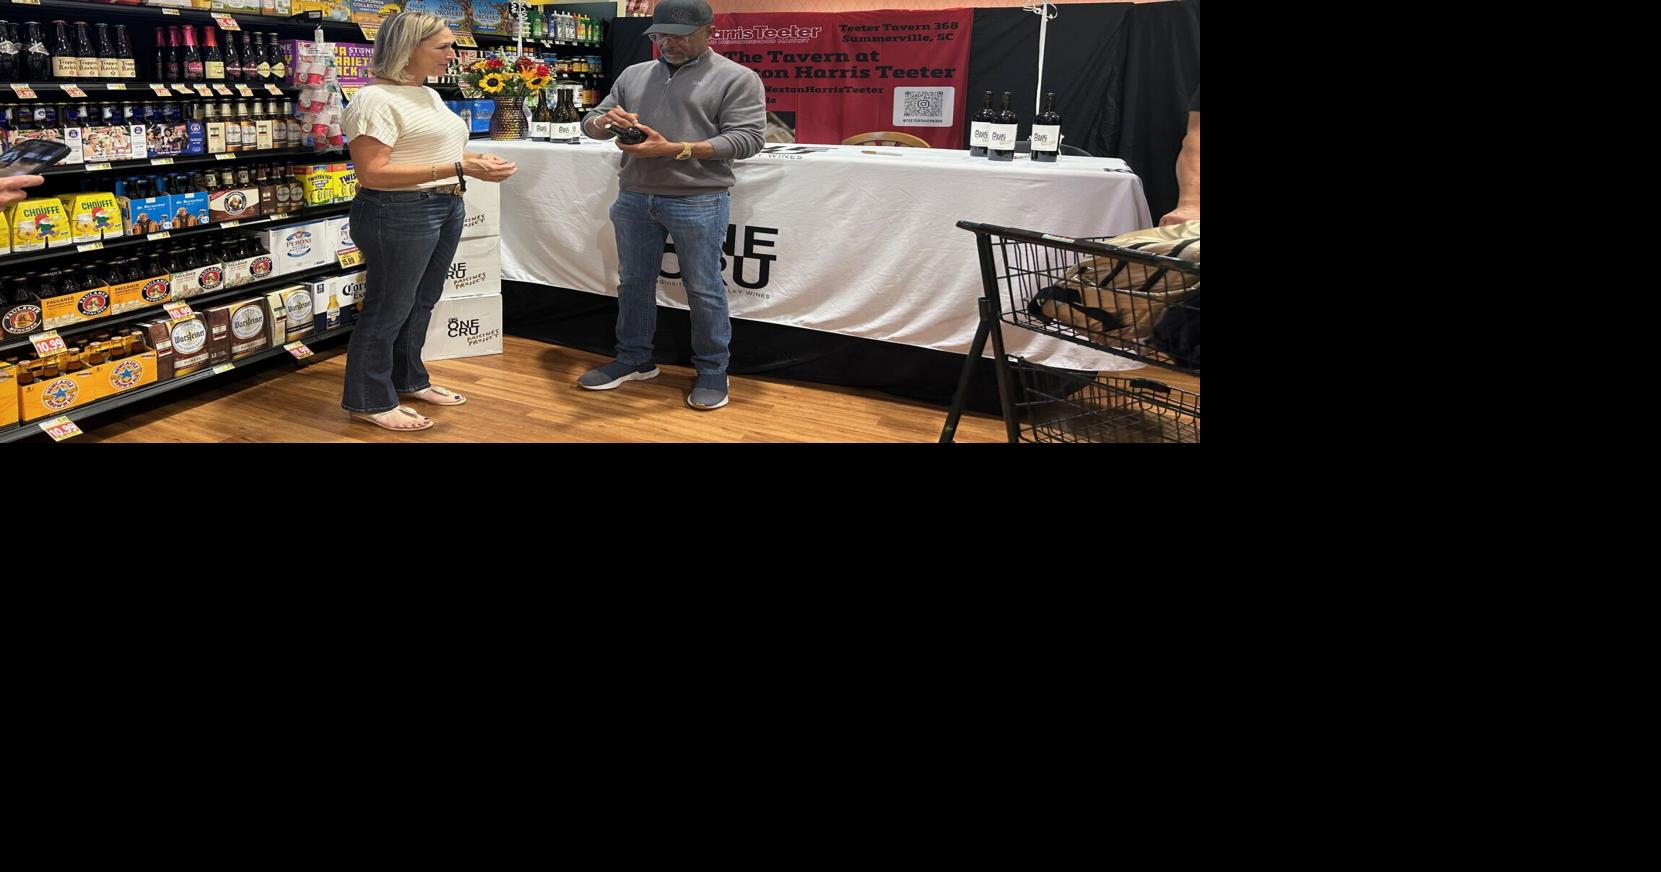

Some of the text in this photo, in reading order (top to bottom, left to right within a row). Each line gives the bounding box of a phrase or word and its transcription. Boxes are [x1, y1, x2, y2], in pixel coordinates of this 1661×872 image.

[838, 24, 880, 32] Teeter
[882, 23, 930, 32] Tavern
[842, 34, 934, 43] Summerville,
[723, 50, 880, 63] The Tavern at
[795, 66, 870, 79] Harris
[876, 66, 956, 78] Teeter
[82, 200, 114, 210] CHOUFFE
[24, 206, 60, 217] CHOUFFE
[287, 238, 311, 247] PERONI
[455, 277, 486, 290] PROJECT
[746, 290, 770, 299] WINES
[6, 306, 40, 319] PAULANER
[448, 319, 480, 329] ONE
[174, 330, 205, 343] Warsteiner
[448, 327, 479, 337] CRU
[36, 339, 63, 352] 10.99
[468, 334, 499, 346] PROJECT
[47, 380, 73, 394] NEWCASTLE
[50, 422, 76, 438] 10.99
